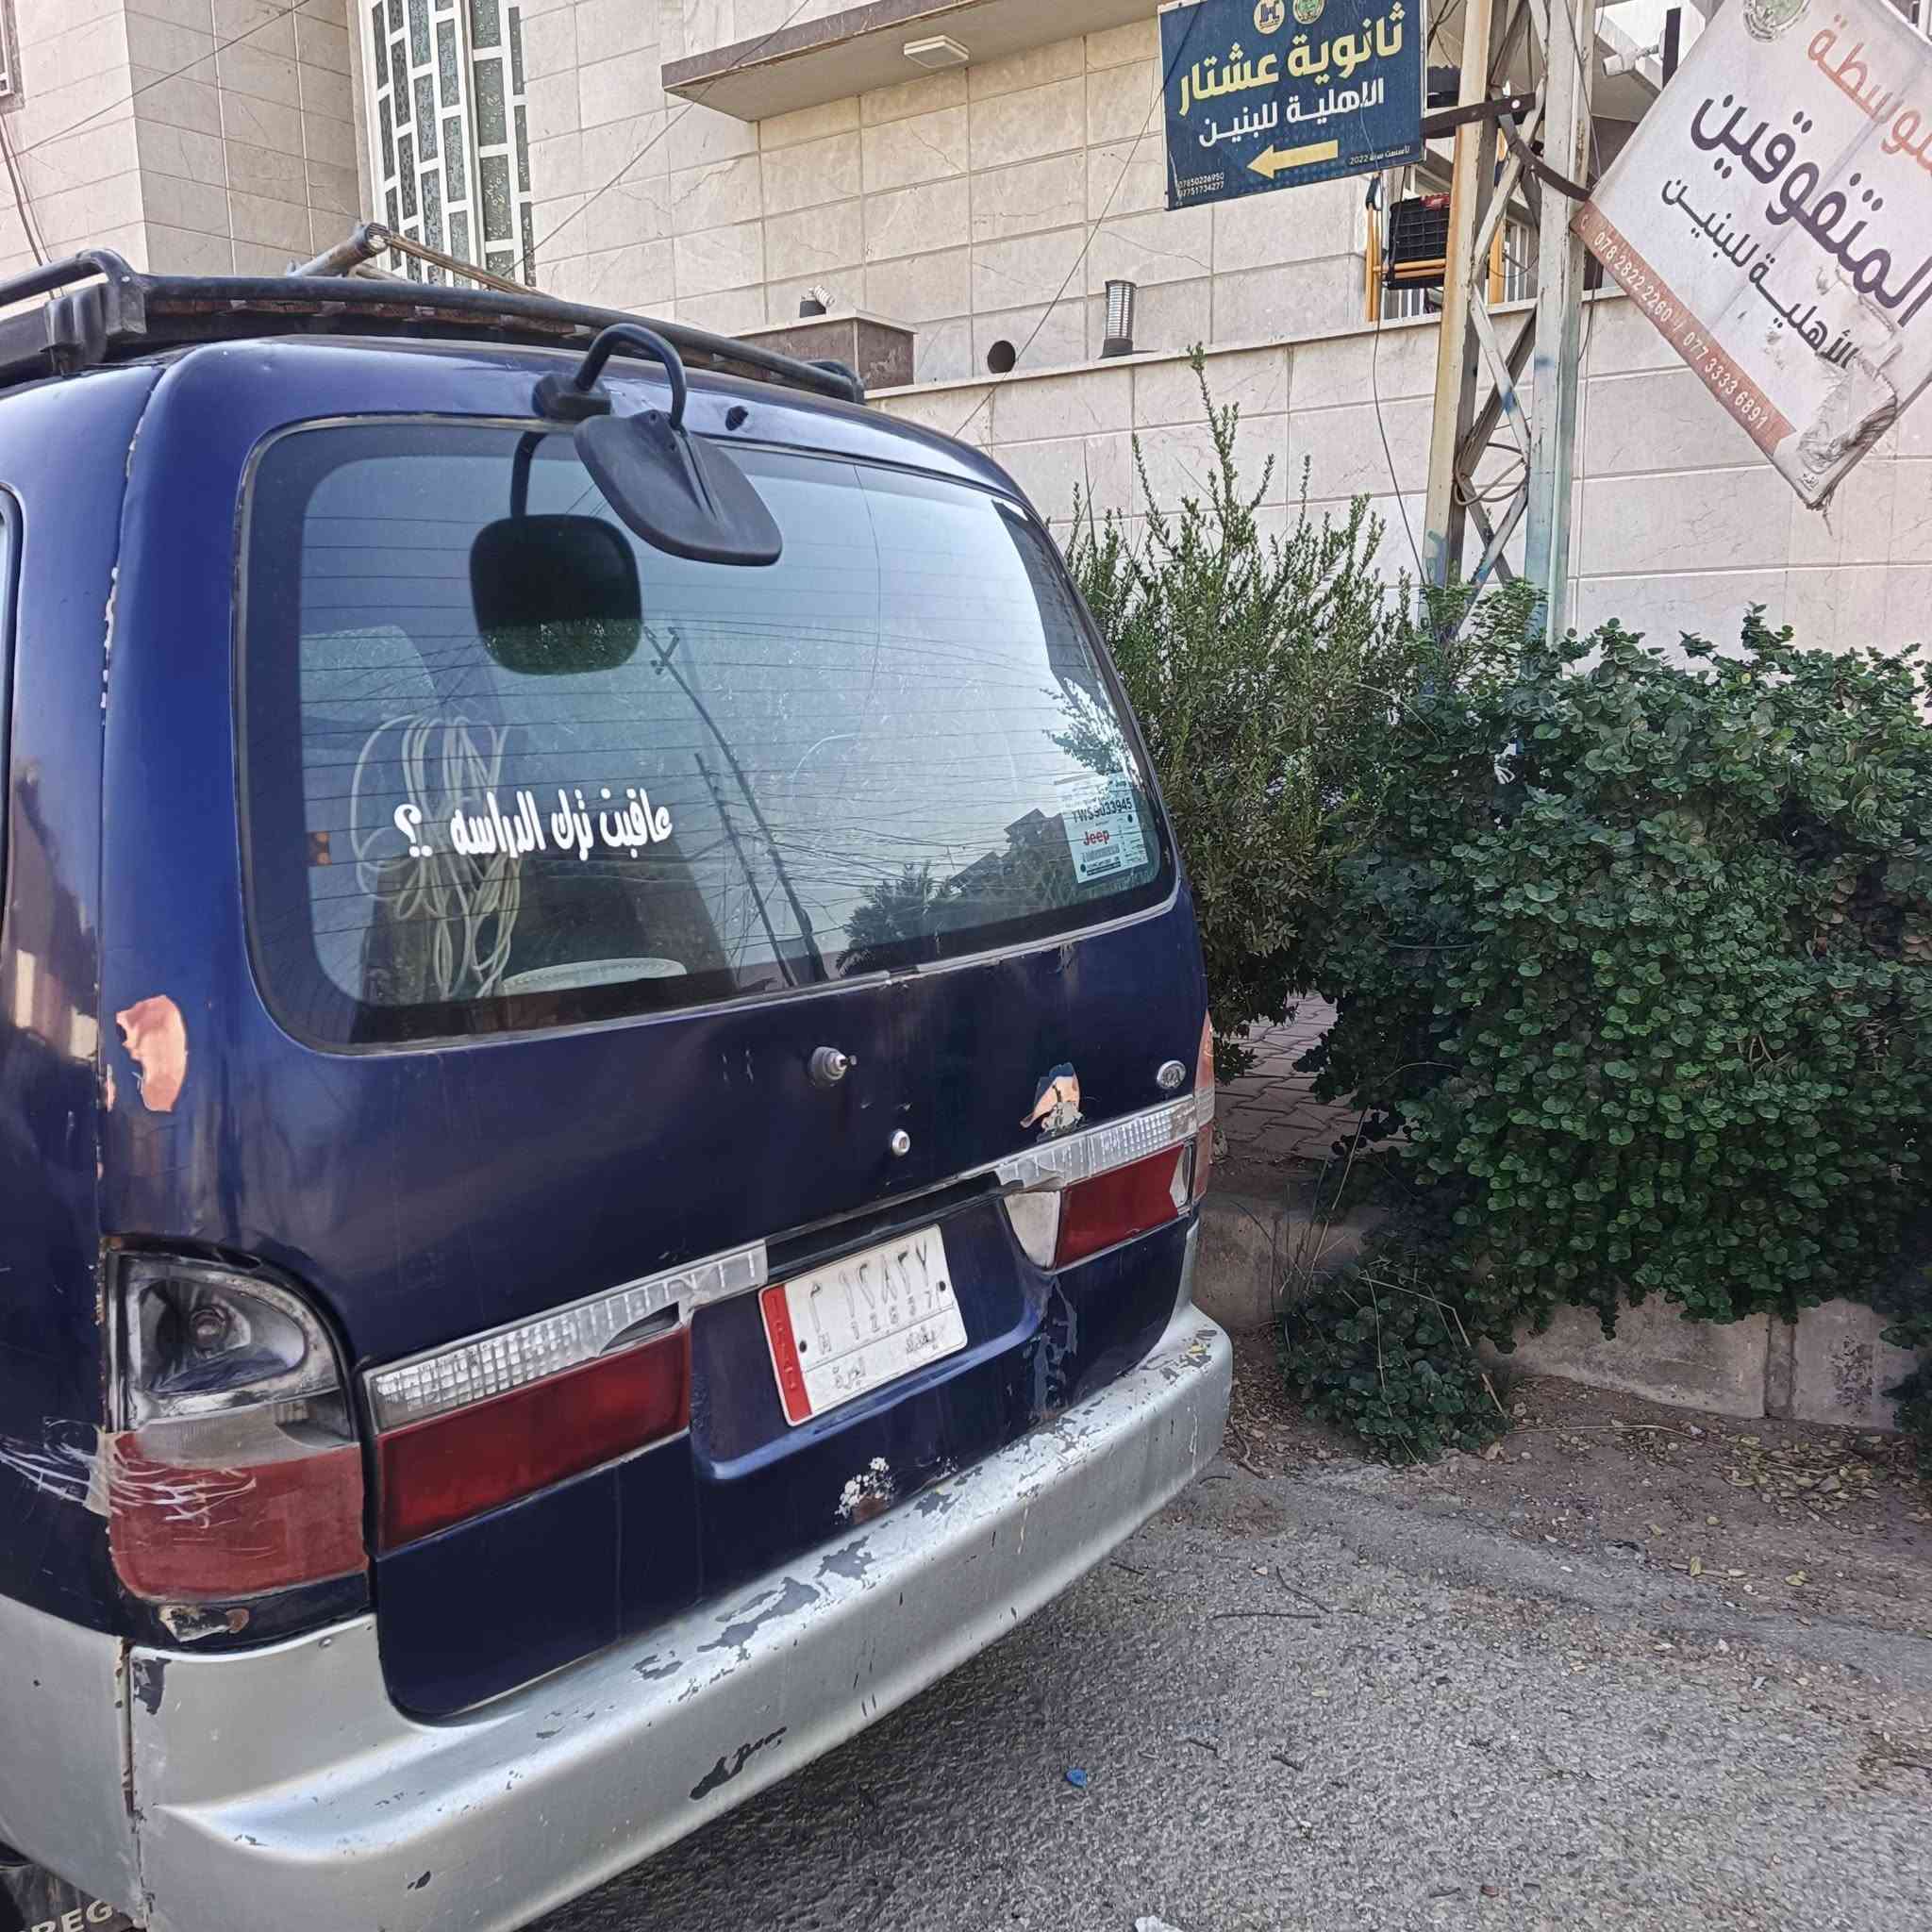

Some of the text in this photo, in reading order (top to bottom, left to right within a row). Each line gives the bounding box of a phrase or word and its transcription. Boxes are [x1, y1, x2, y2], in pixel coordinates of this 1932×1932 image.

[1179, 1, 1406, 116] ثانوية عشتار
[1199, 101, 1277, 147] للبنين
[1349, 155, 1369, 167] 2022
[1661, 179, 1759, 268] للبنين
[1594, 231, 1617, 259] 078
[1614, 255, 1645, 291] 2822
[1641, 285, 1673, 323] 2260
[1683, 331, 1709, 360] 077
[1705, 358, 1739, 394] 3333
[1735, 391, 1769, 430] 6891
[1083, 830, 1109, 846] Jeep
